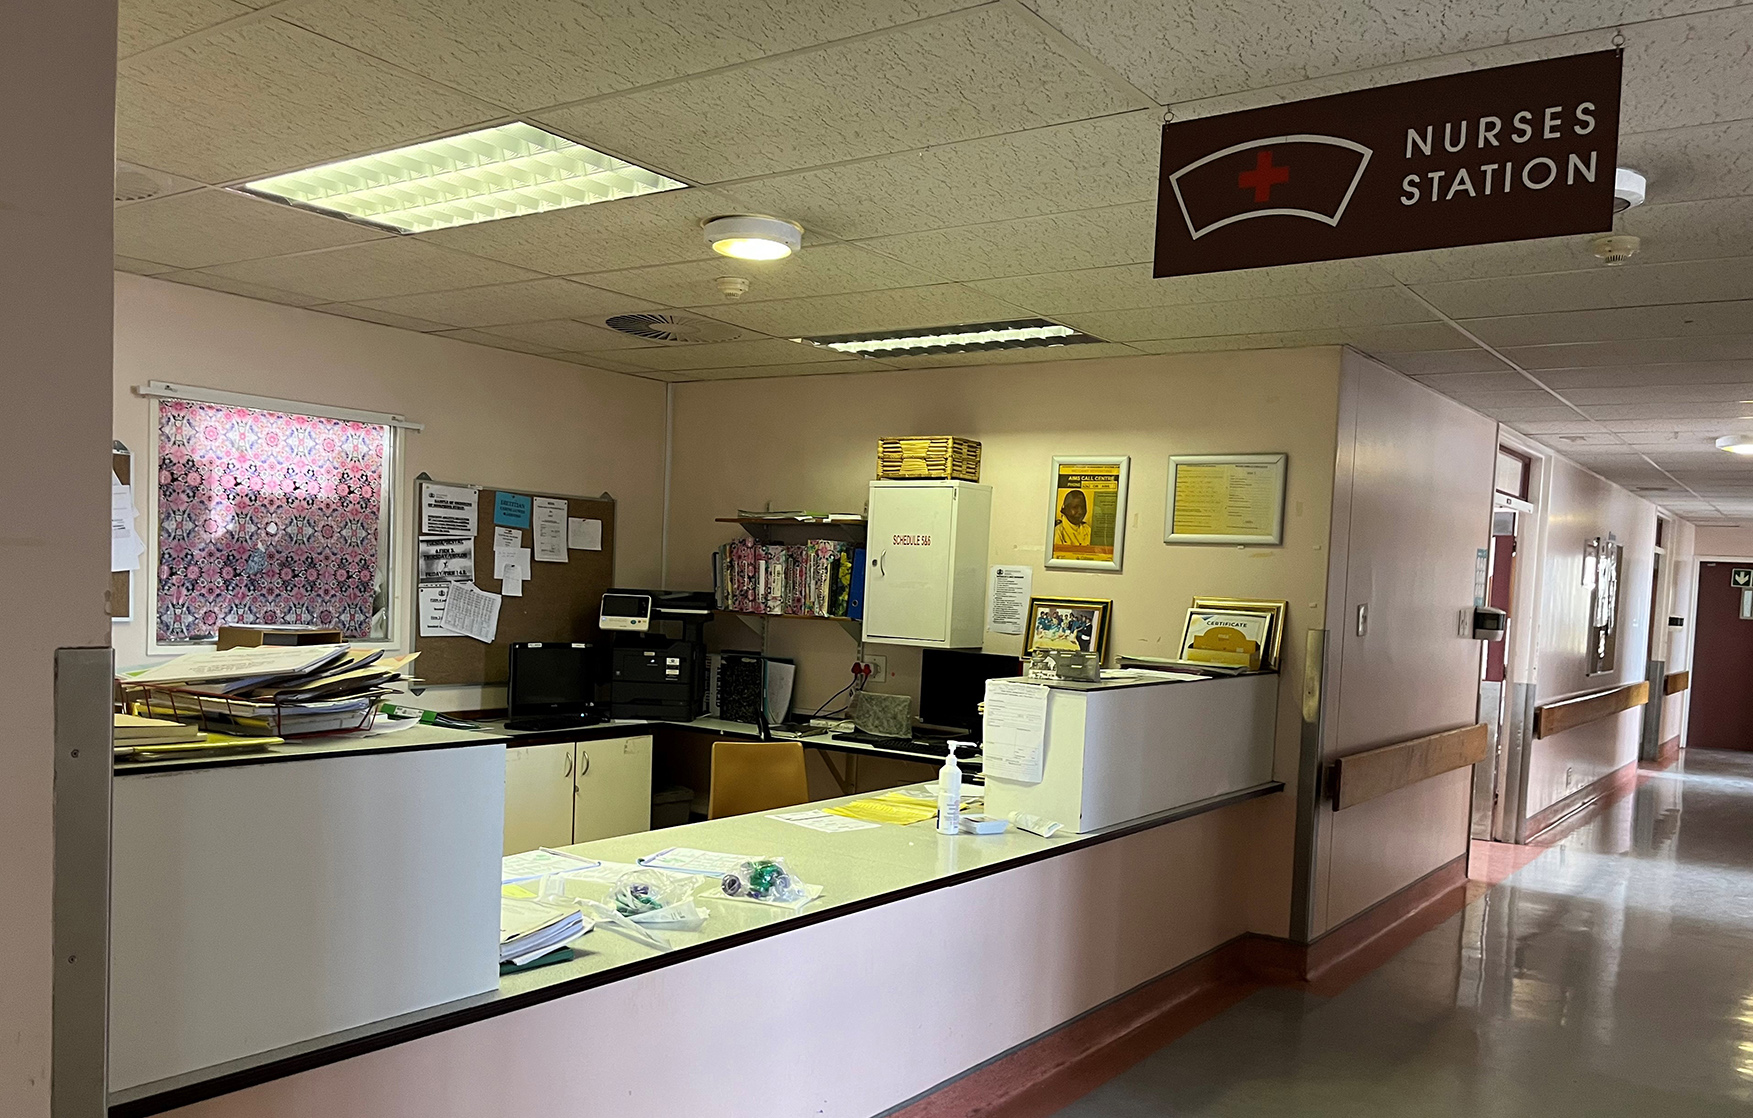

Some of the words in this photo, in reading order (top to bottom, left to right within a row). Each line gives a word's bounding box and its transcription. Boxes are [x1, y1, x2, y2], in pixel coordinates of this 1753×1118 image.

[1405, 101, 1597, 159] NURSES
[1400, 150, 1598, 207] STATION
[893, 534, 920, 546] SCHEDULE
